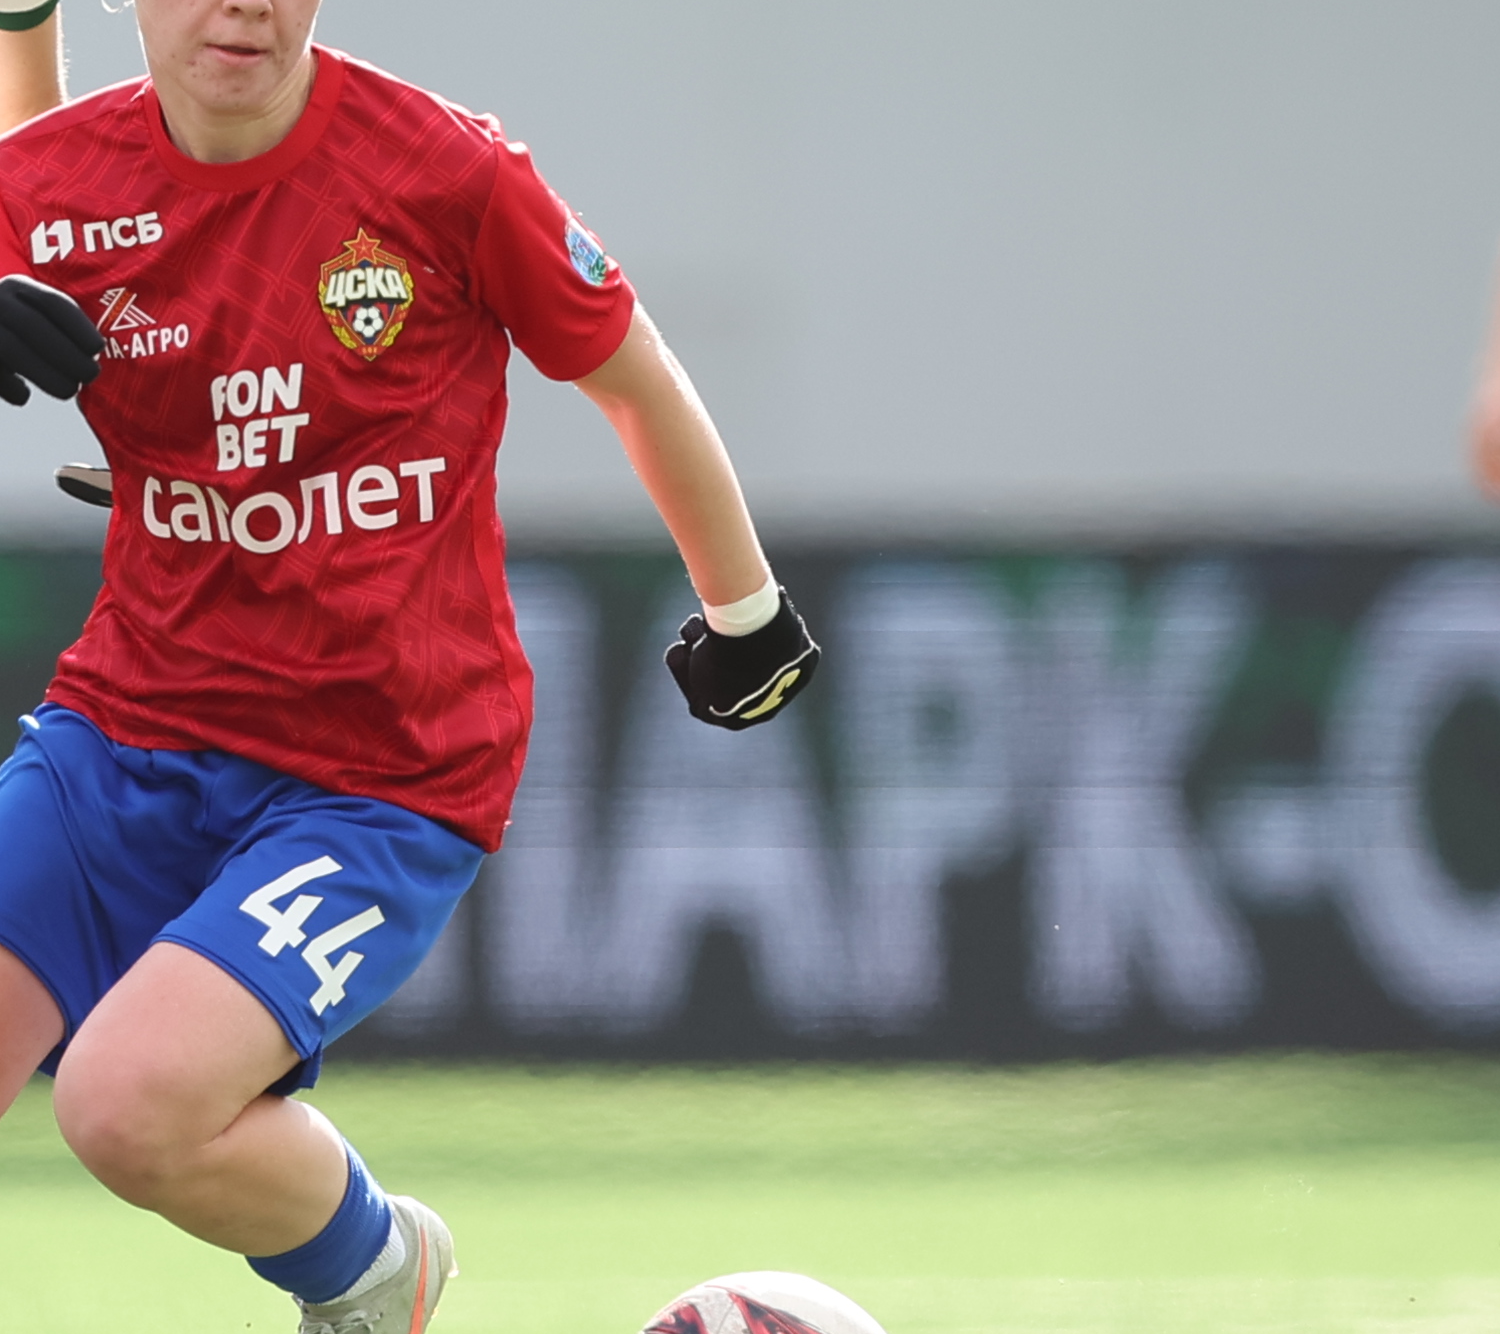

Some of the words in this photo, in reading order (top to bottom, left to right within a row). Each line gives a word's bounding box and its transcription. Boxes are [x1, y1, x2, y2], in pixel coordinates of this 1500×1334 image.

[82, 211, 163, 253] ПСБ
[324, 266, 409, 308] ЦСКА
[210, 363, 303, 421] FON
[216, 412, 310, 472] BET
[238, 855, 386, 1016] 44
